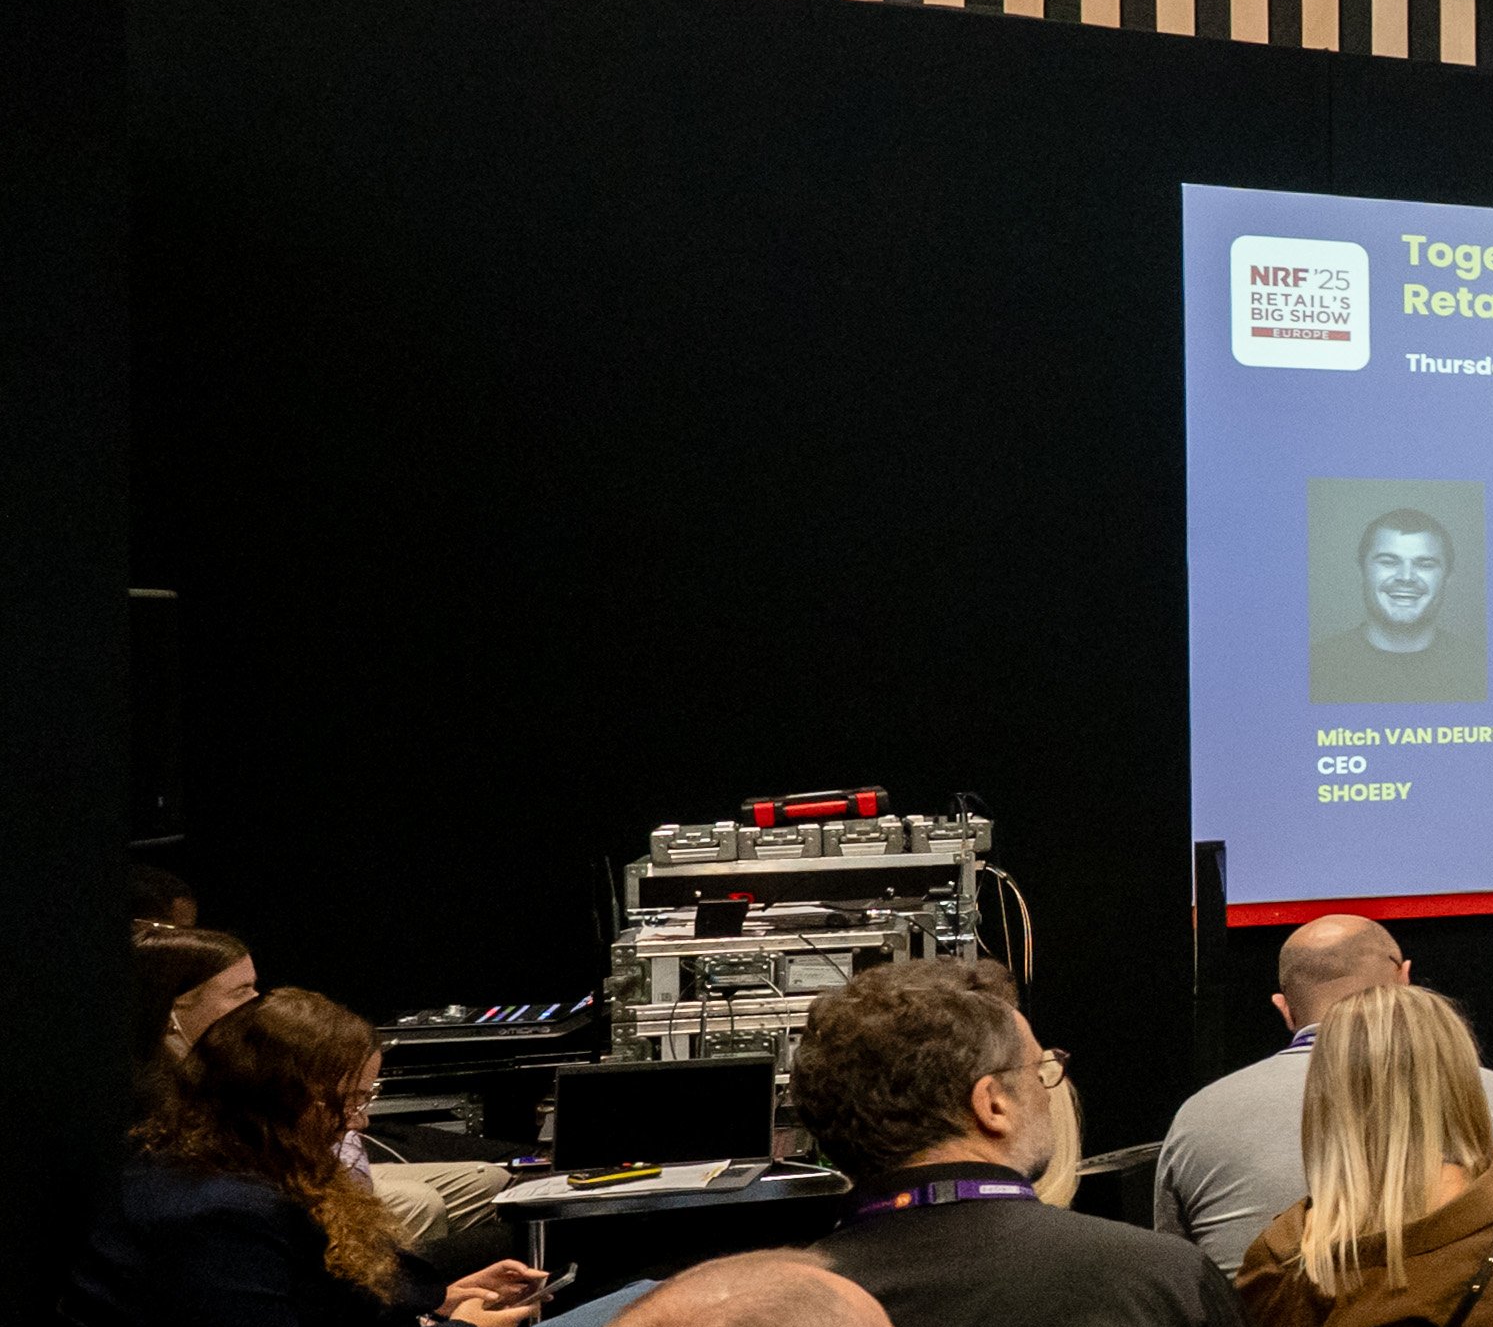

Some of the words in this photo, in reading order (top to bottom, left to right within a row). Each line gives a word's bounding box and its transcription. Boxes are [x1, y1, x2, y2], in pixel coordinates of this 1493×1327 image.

[1250, 264, 1309, 288] NRF
[1314, 268, 1351, 292] '25
[1251, 292, 1351, 309] RETAIL'S
[1251, 307, 1284, 322] BIG
[1290, 310, 1351, 325] SHOW
[1272, 328, 1330, 340] EUROPE
[1318, 727, 1379, 746] Mitch
[1384, 727, 1433, 744] VAN
[1318, 755, 1367, 774] CEO
[1318, 782, 1412, 803] SHOEBY
